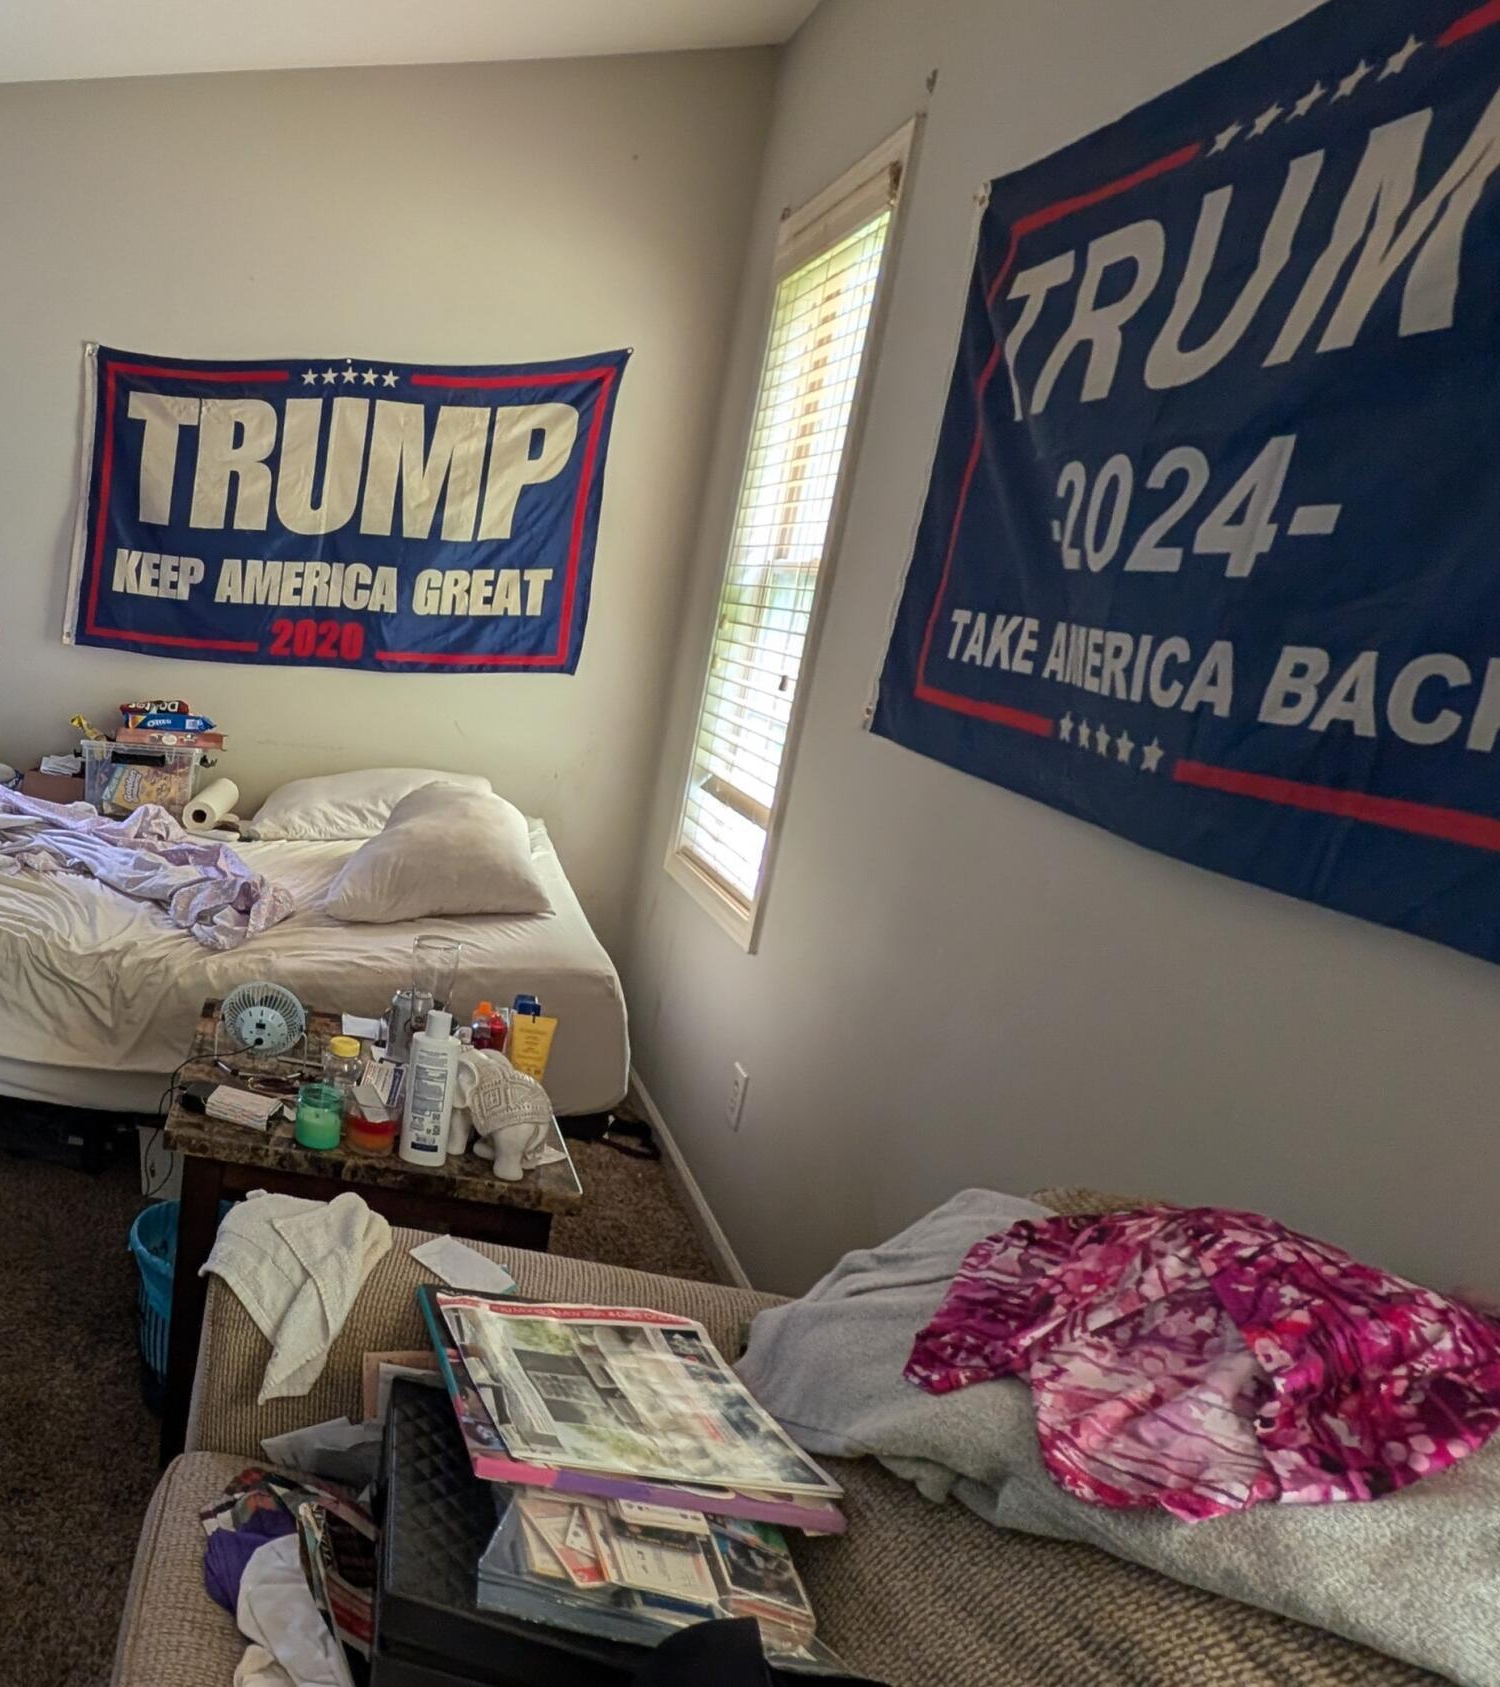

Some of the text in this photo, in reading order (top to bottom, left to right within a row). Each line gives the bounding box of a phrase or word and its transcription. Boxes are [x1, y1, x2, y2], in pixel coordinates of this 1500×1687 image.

[128, 390, 579, 542] TRUMP
[112, 548, 553, 616] KEEP AMERICA GREAT
[268, 618, 366, 661] 2020
[947, 609, 1039, 675] TAKE
[1042, 622, 1234, 718] AMERICA
